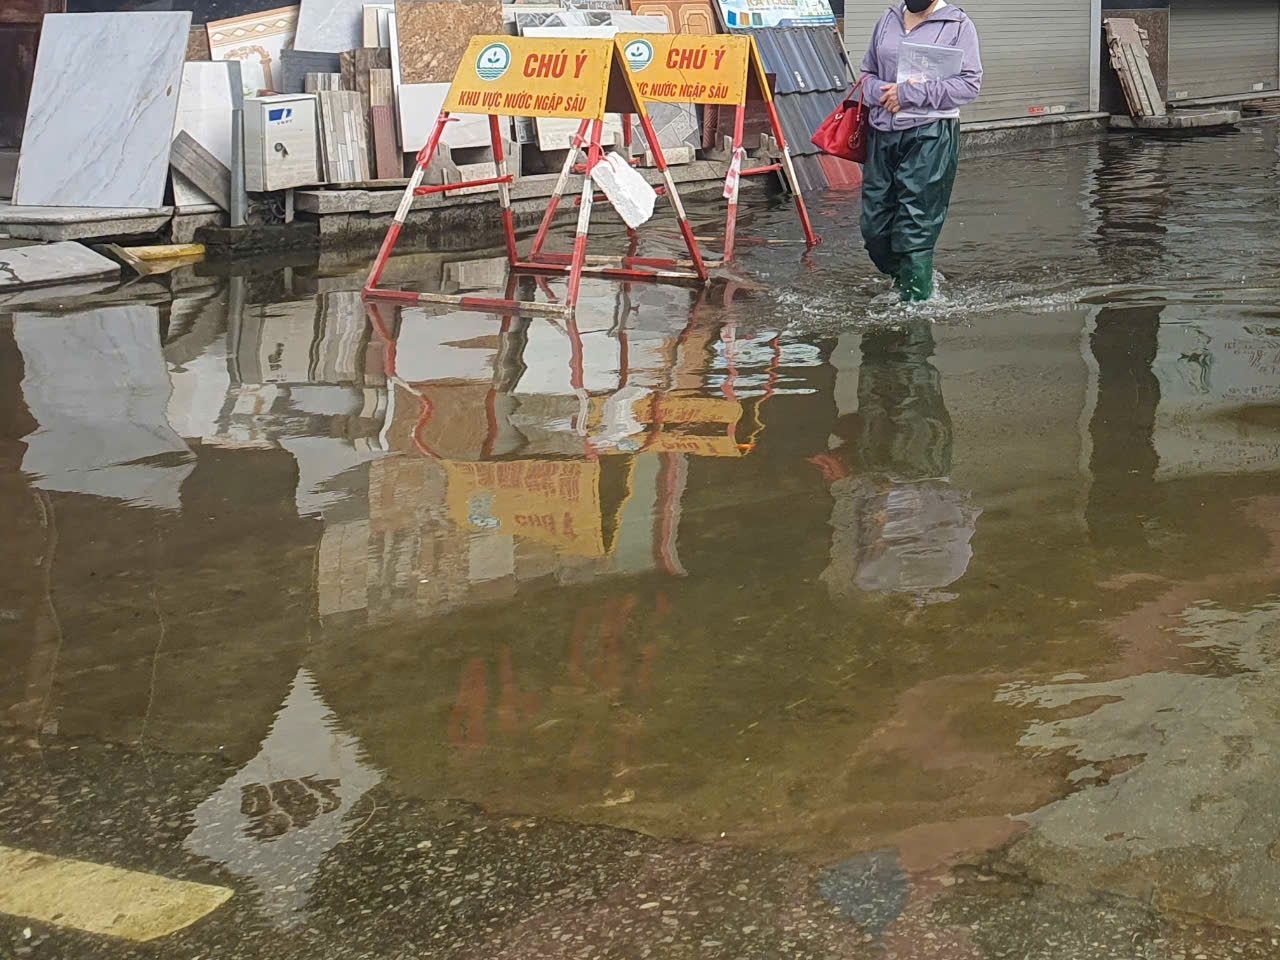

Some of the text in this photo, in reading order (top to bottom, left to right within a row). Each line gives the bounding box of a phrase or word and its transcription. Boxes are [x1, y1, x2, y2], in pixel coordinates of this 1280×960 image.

[523, 48, 589, 78] CHÚ Ý
[666, 45, 726, 70] CHÚ Ý
[458, 90, 587, 114] KHU VỰC NƯỚC NGẬP SÂU
[650, 81, 677, 97] NƯỚC
[678, 82, 706, 100] NGẬP
[708, 83, 729, 99] SÂU
